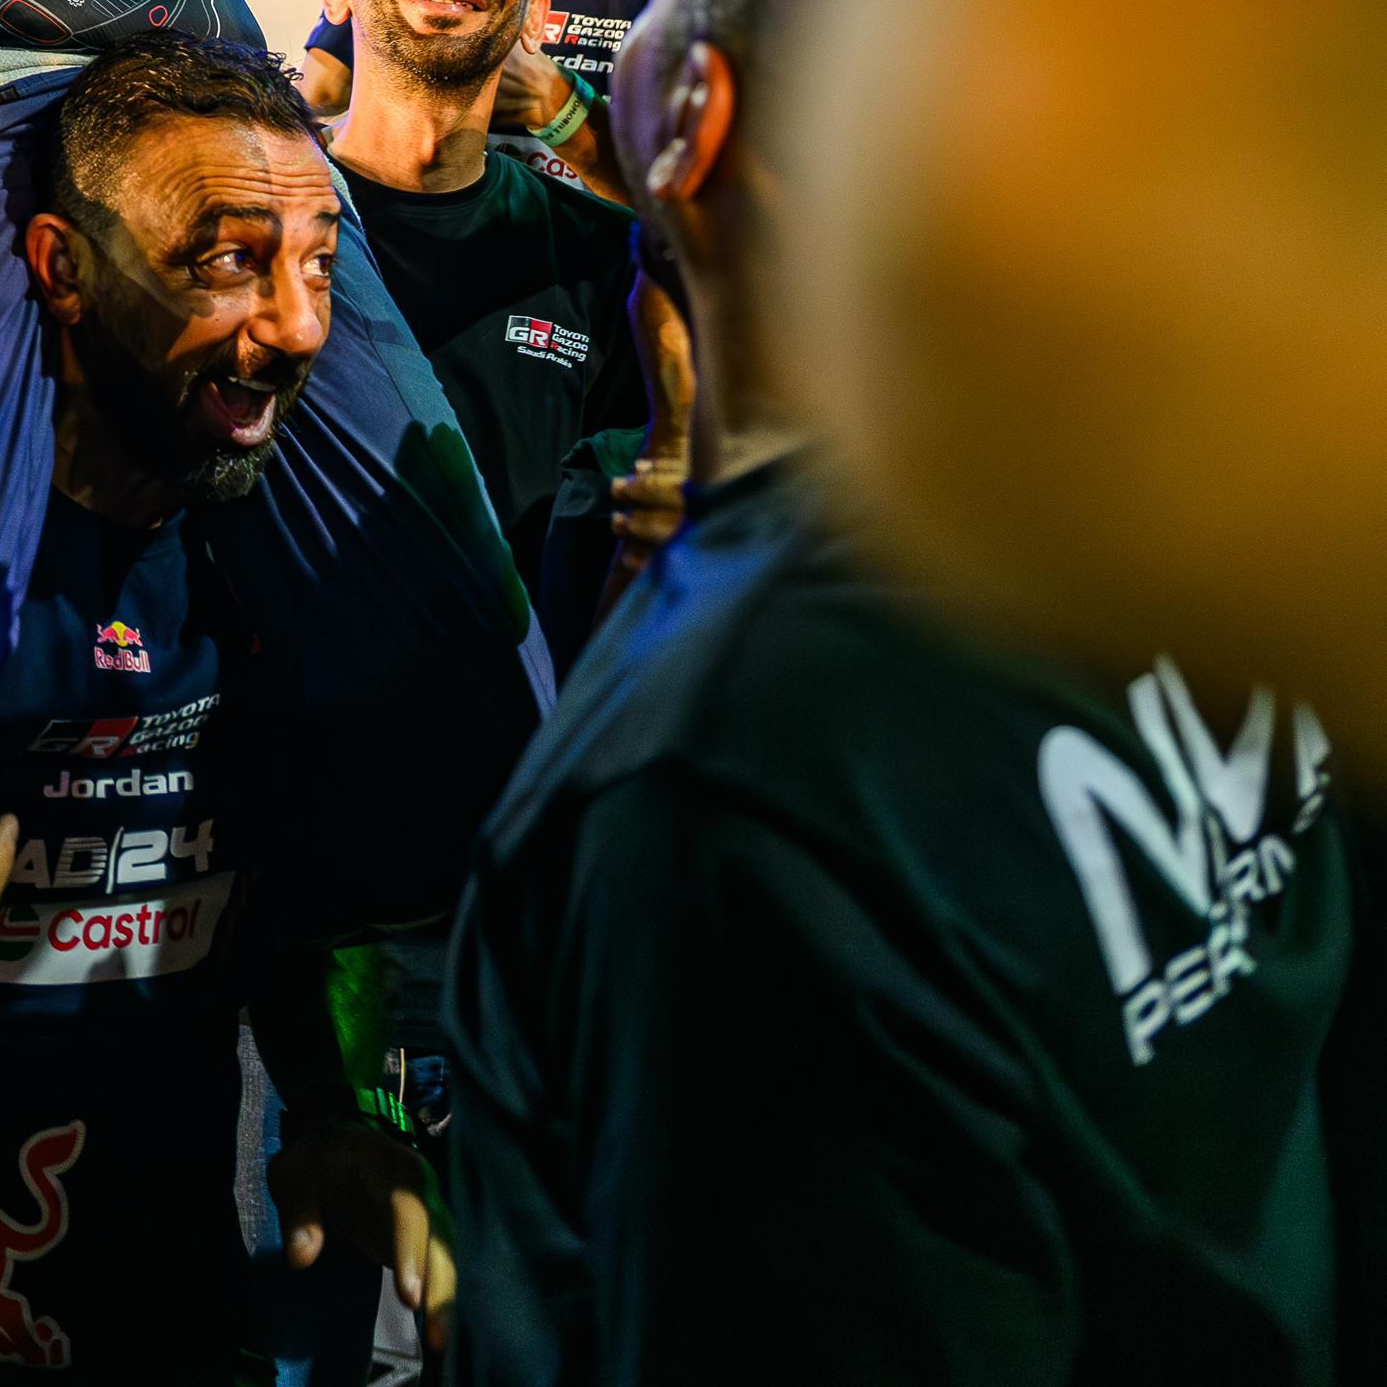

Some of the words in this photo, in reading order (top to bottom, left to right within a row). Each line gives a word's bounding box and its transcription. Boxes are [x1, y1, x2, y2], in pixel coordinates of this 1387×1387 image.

[571, 13, 632, 30] TOYOTA
[567, 24, 625, 40] GAZOO
[564, 34, 622, 52] Racing
[508, 326, 548, 346] GR
[551, 333, 589, 352] GAZOO
[517, 345, 546, 359] Saudi
[545, 352, 573, 368] Arabia
[550, 342, 587, 362] Racing
[94, 645, 124, 671] Red
[124, 648, 151, 674] Bull
[141, 693, 221, 728] TOYOTA
[43, 768, 195, 799] Jordan
[46, 898, 202, 953] Castrol
